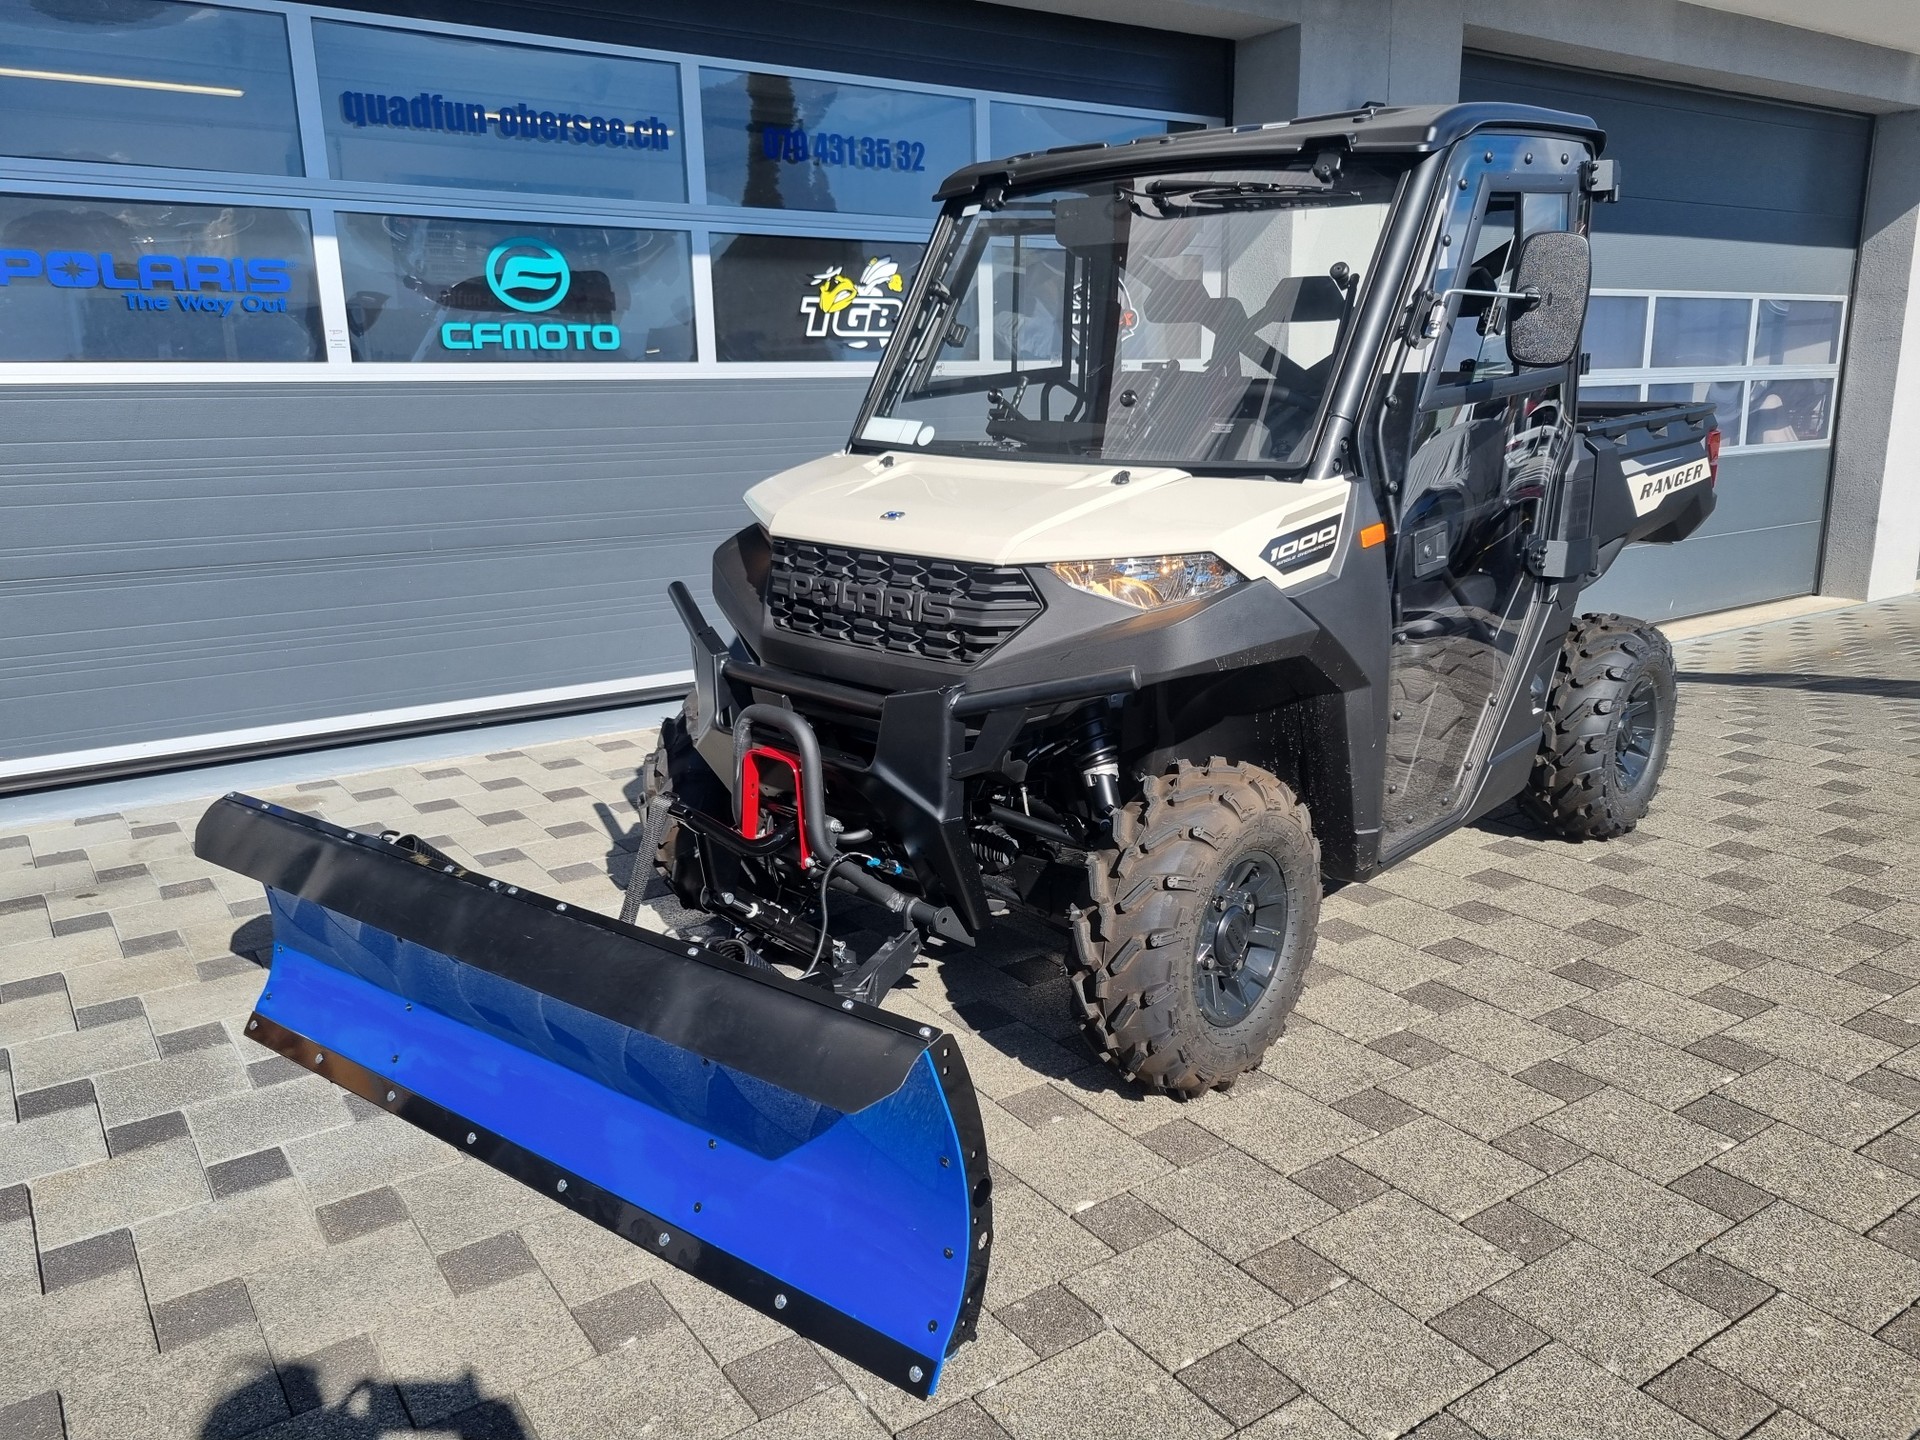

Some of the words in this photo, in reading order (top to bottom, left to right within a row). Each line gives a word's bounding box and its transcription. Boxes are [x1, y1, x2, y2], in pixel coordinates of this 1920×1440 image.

[342, 90, 669, 150] quadfun-obersee.ch
[763, 127, 808, 162] 079
[814, 133, 856, 166] 431
[860, 136, 891, 169] 35
[896, 140, 925, 172] 32
[0, 249, 292, 293] POLARIS
[125, 292, 170, 311] The
[176, 293, 234, 317] Way
[241, 295, 287, 313] Out
[441, 322, 621, 350] CFMOTO
[1640, 463, 1704, 501] RANGER
[1270, 524, 1337, 562] 1000
[788, 570, 956, 626] POLARIS
